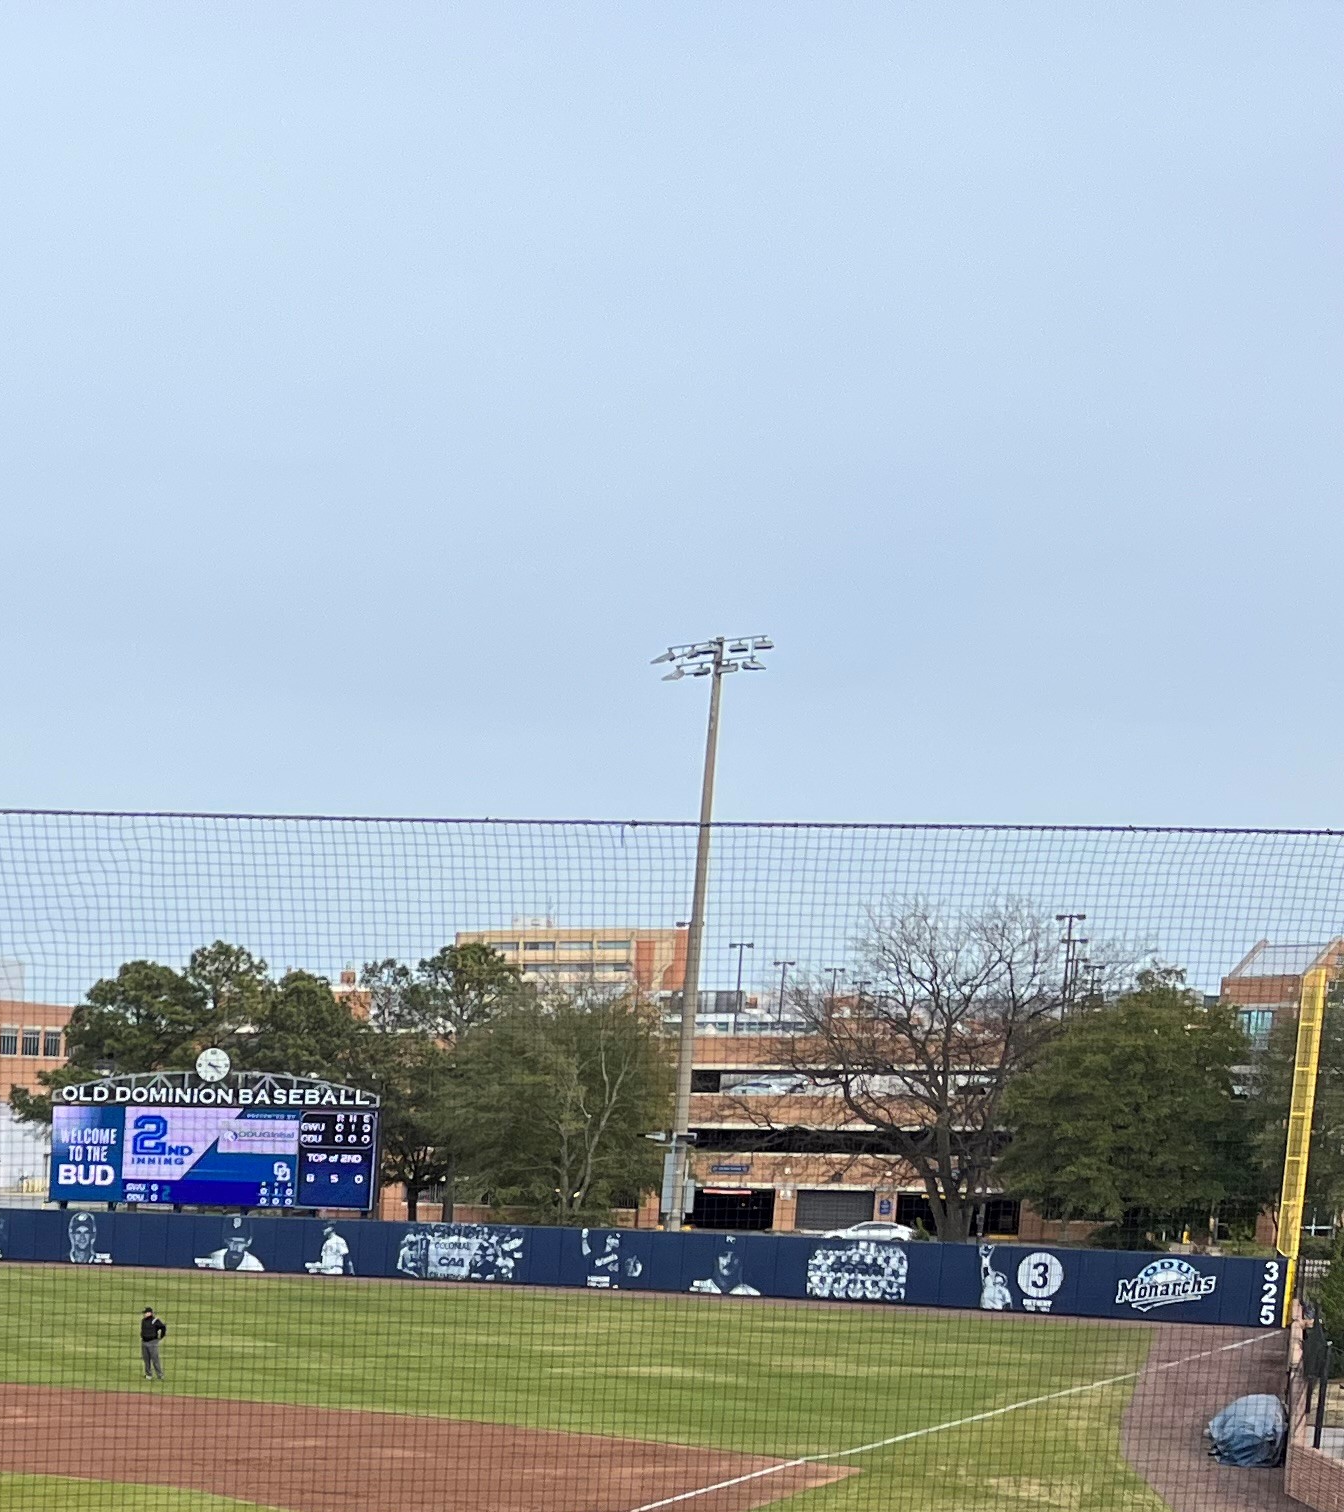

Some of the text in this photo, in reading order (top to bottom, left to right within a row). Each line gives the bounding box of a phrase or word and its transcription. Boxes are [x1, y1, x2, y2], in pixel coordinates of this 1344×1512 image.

[62, 1085, 370, 1105] OLD DOMINION BASEBALL
[61, 1128, 118, 1145] WELCOME
[300, 1122, 325, 1132] GWU
[68, 1145, 108, 1162] TO THE
[130, 1157, 184, 1166] INNING
[306, 1153, 328, 1162] TOP
[58, 1164, 115, 1186] BUD
[1030, 1262, 1049, 1289] 3
[1142, 1259, 1192, 1279] ODU
[1116, 1275, 1216, 1304] Monarchs
[1259, 1261, 1280, 1326] 325
